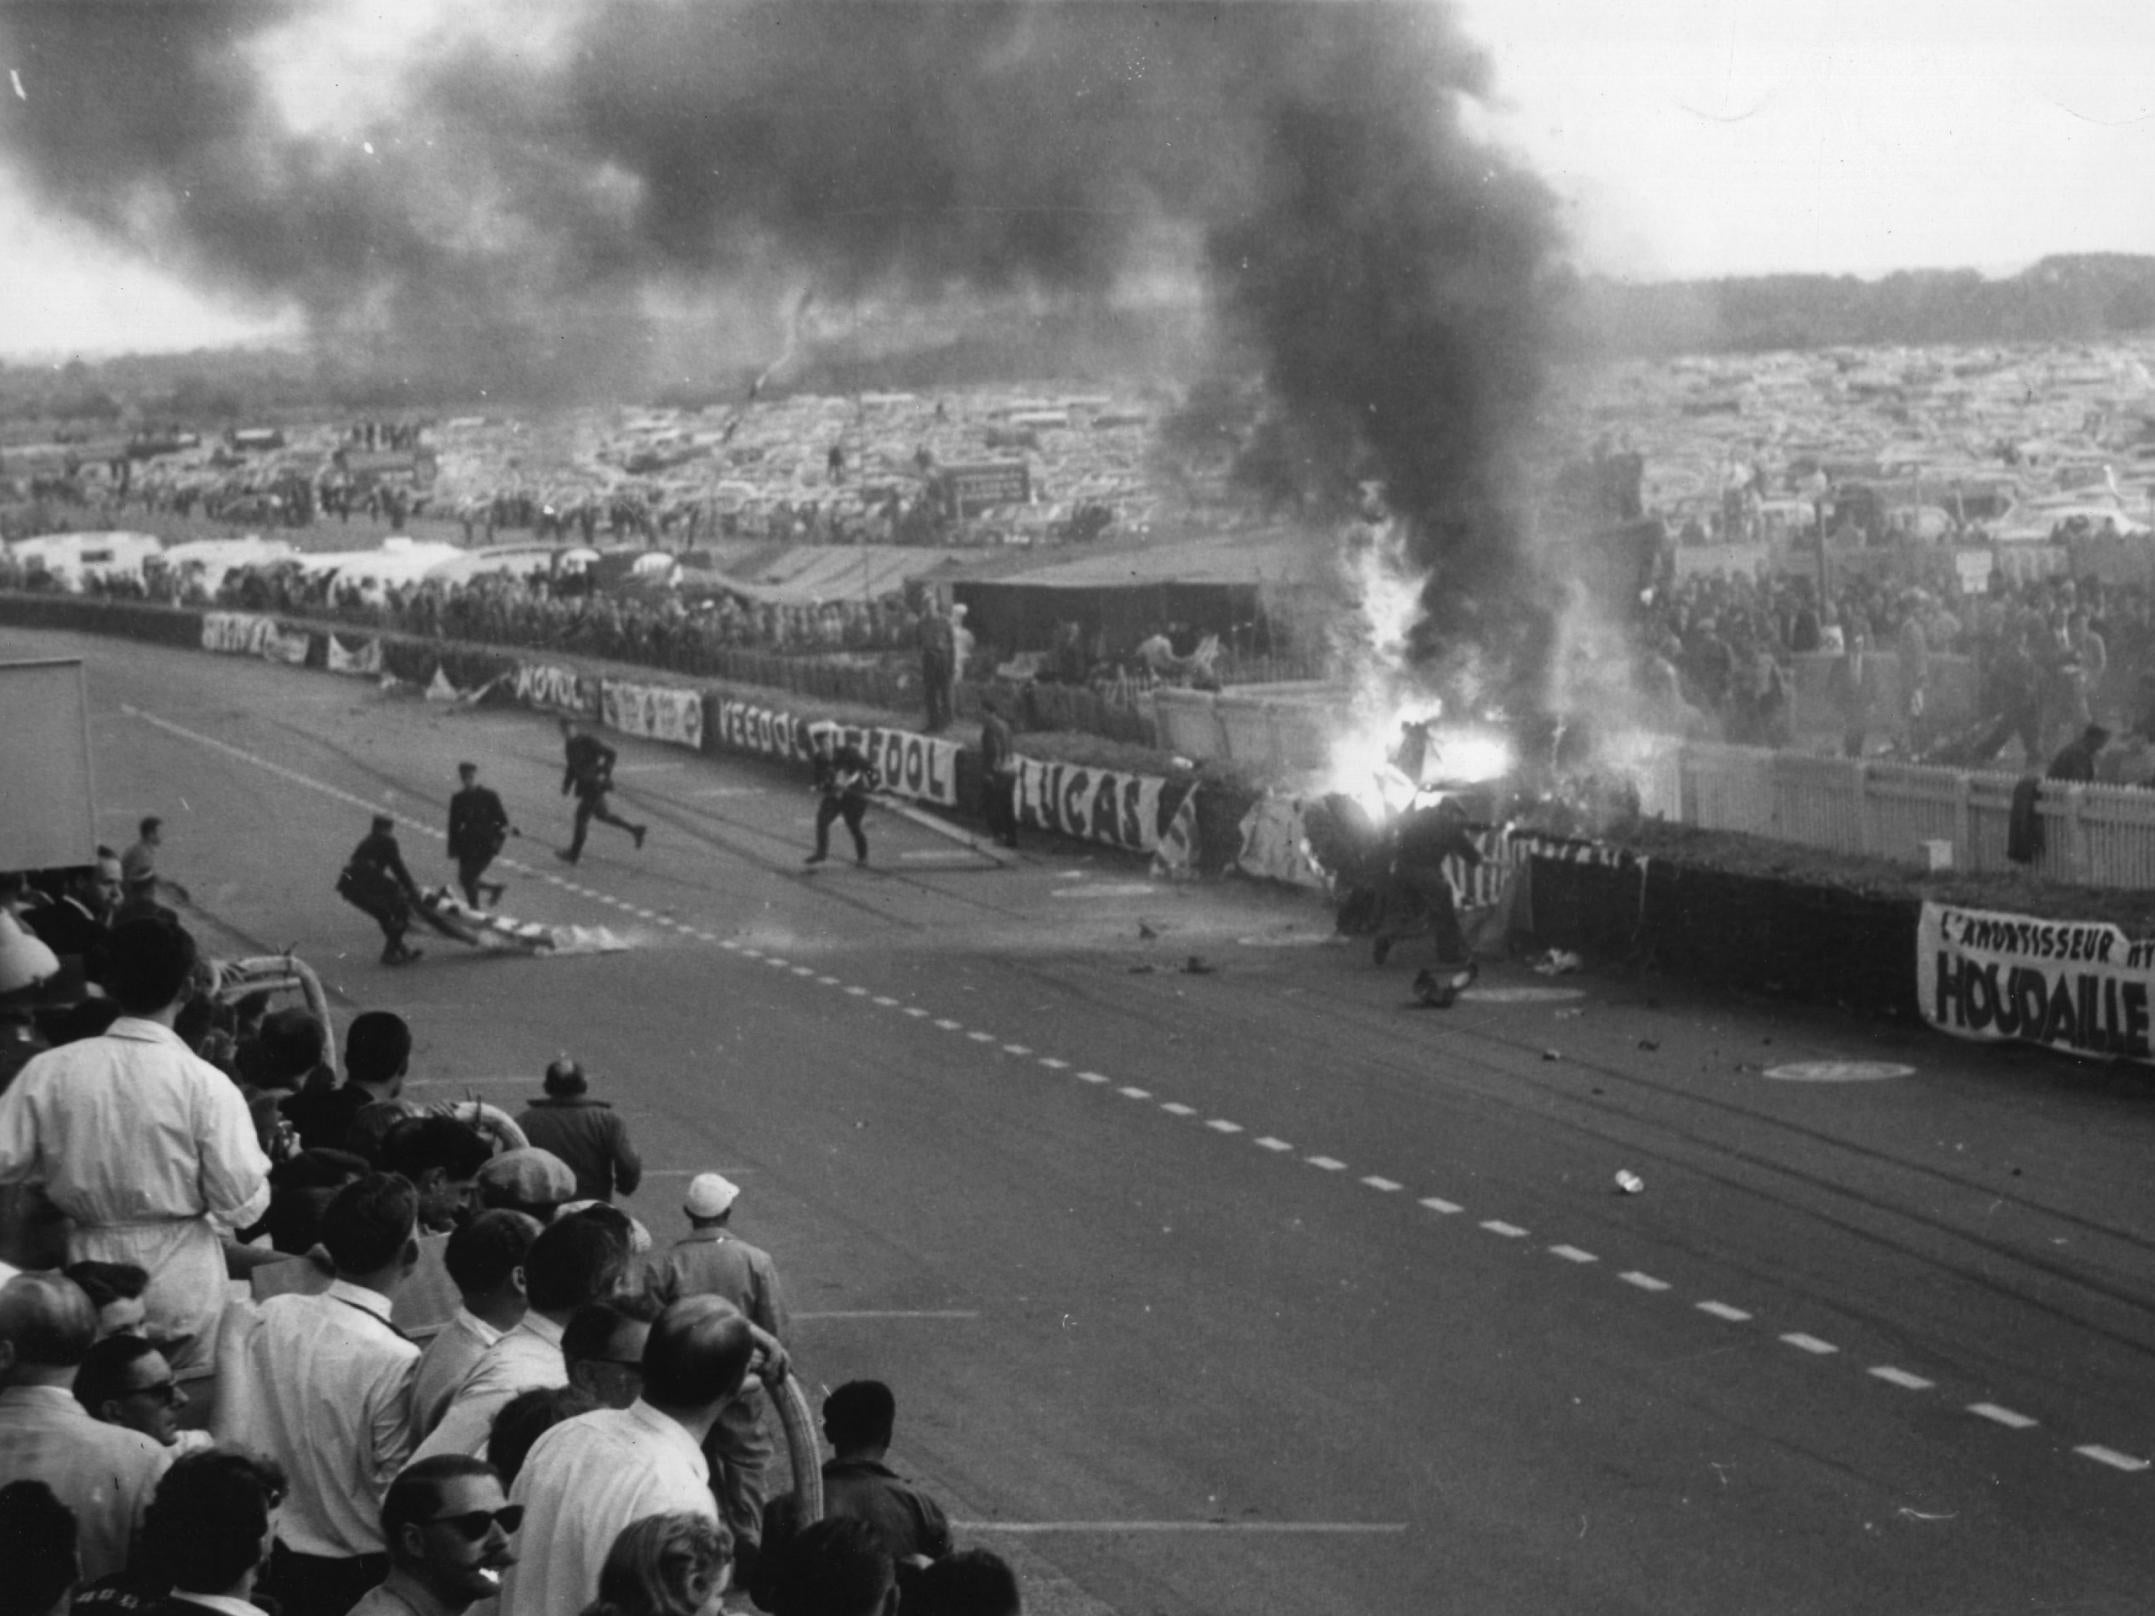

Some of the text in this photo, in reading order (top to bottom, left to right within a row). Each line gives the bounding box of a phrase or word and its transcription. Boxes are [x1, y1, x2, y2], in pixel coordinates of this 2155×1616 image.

[720, 700, 809, 762] VEEDOL
[1019, 760, 1143, 848] LUCAS
[1940, 910, 2116, 964] L'AMORTISSEUR
[1936, 950, 2151, 1059] HOUDAILLE
